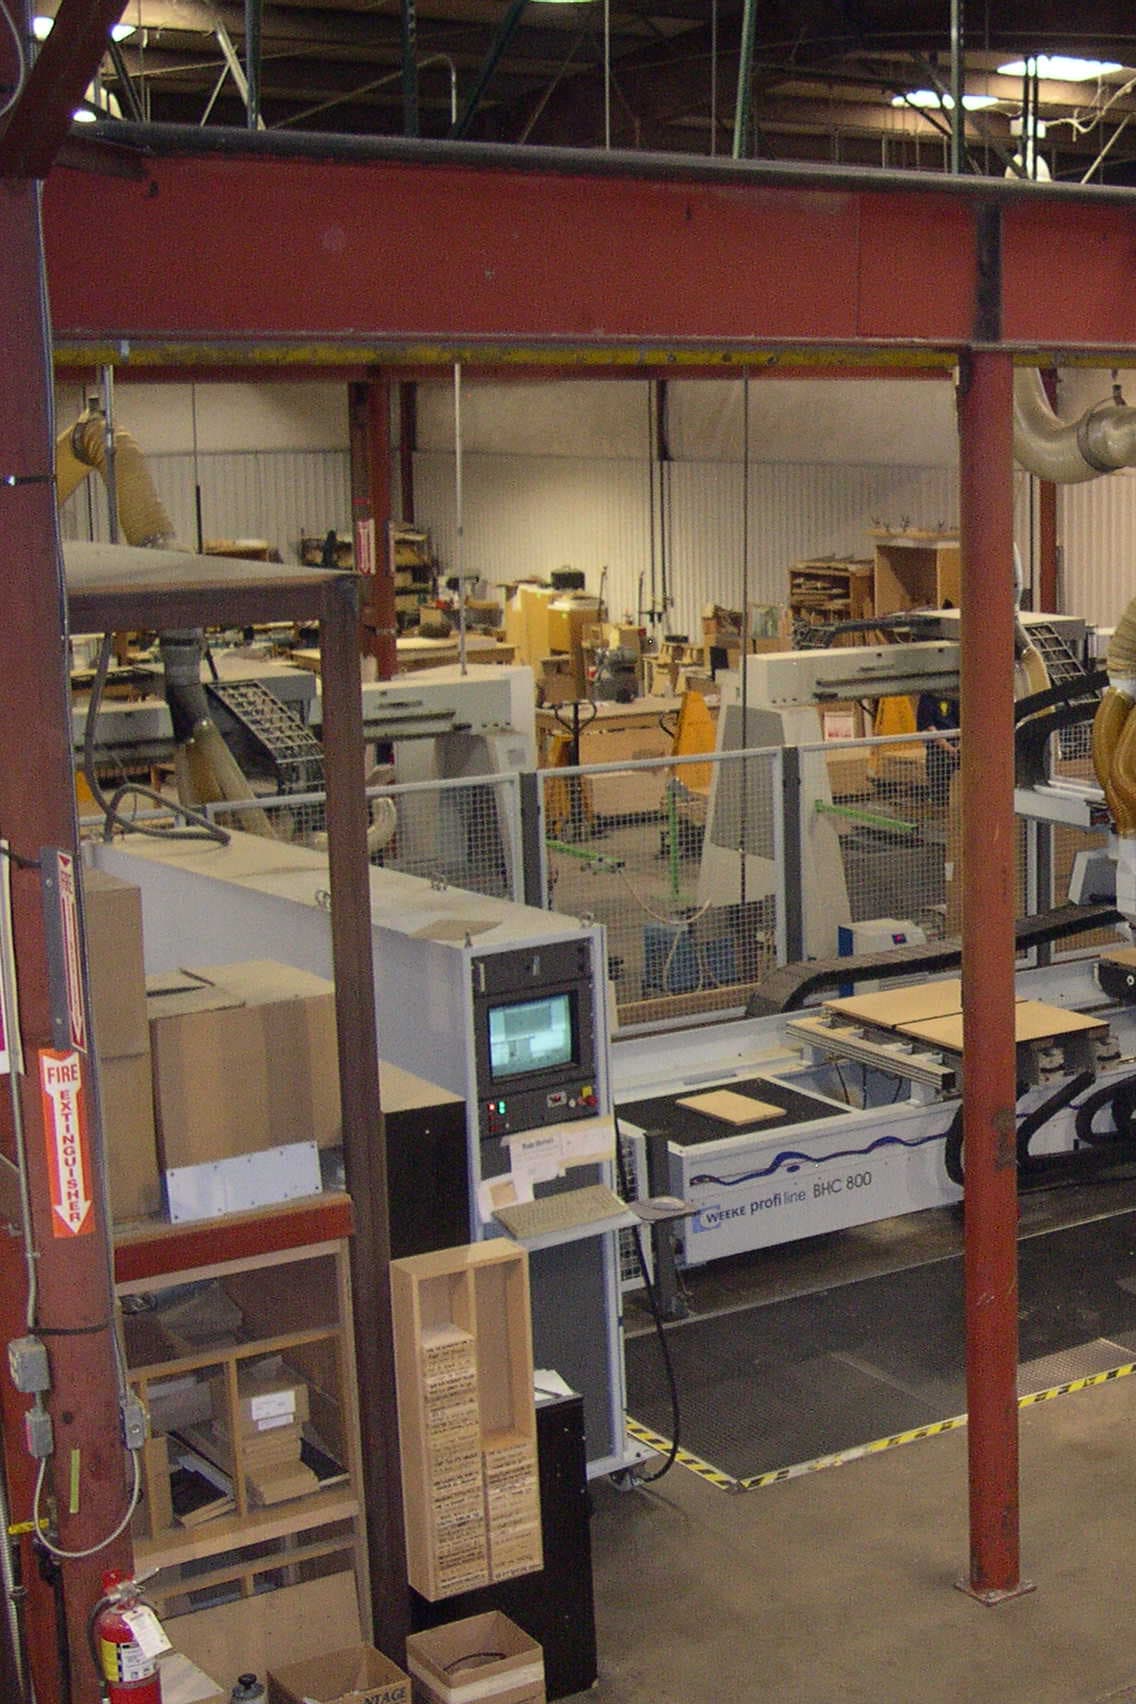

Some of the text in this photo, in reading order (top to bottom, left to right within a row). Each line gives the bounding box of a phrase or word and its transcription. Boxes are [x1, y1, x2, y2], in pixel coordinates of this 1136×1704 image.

[47, 1063, 79, 1084] FIRE
[60, 1089, 81, 1222] EXTINGUISHER
[706, 1206, 746, 1224] WEEKE
[813, 1179, 842, 1199] BHC
[846, 1171, 872, 1190] 800
